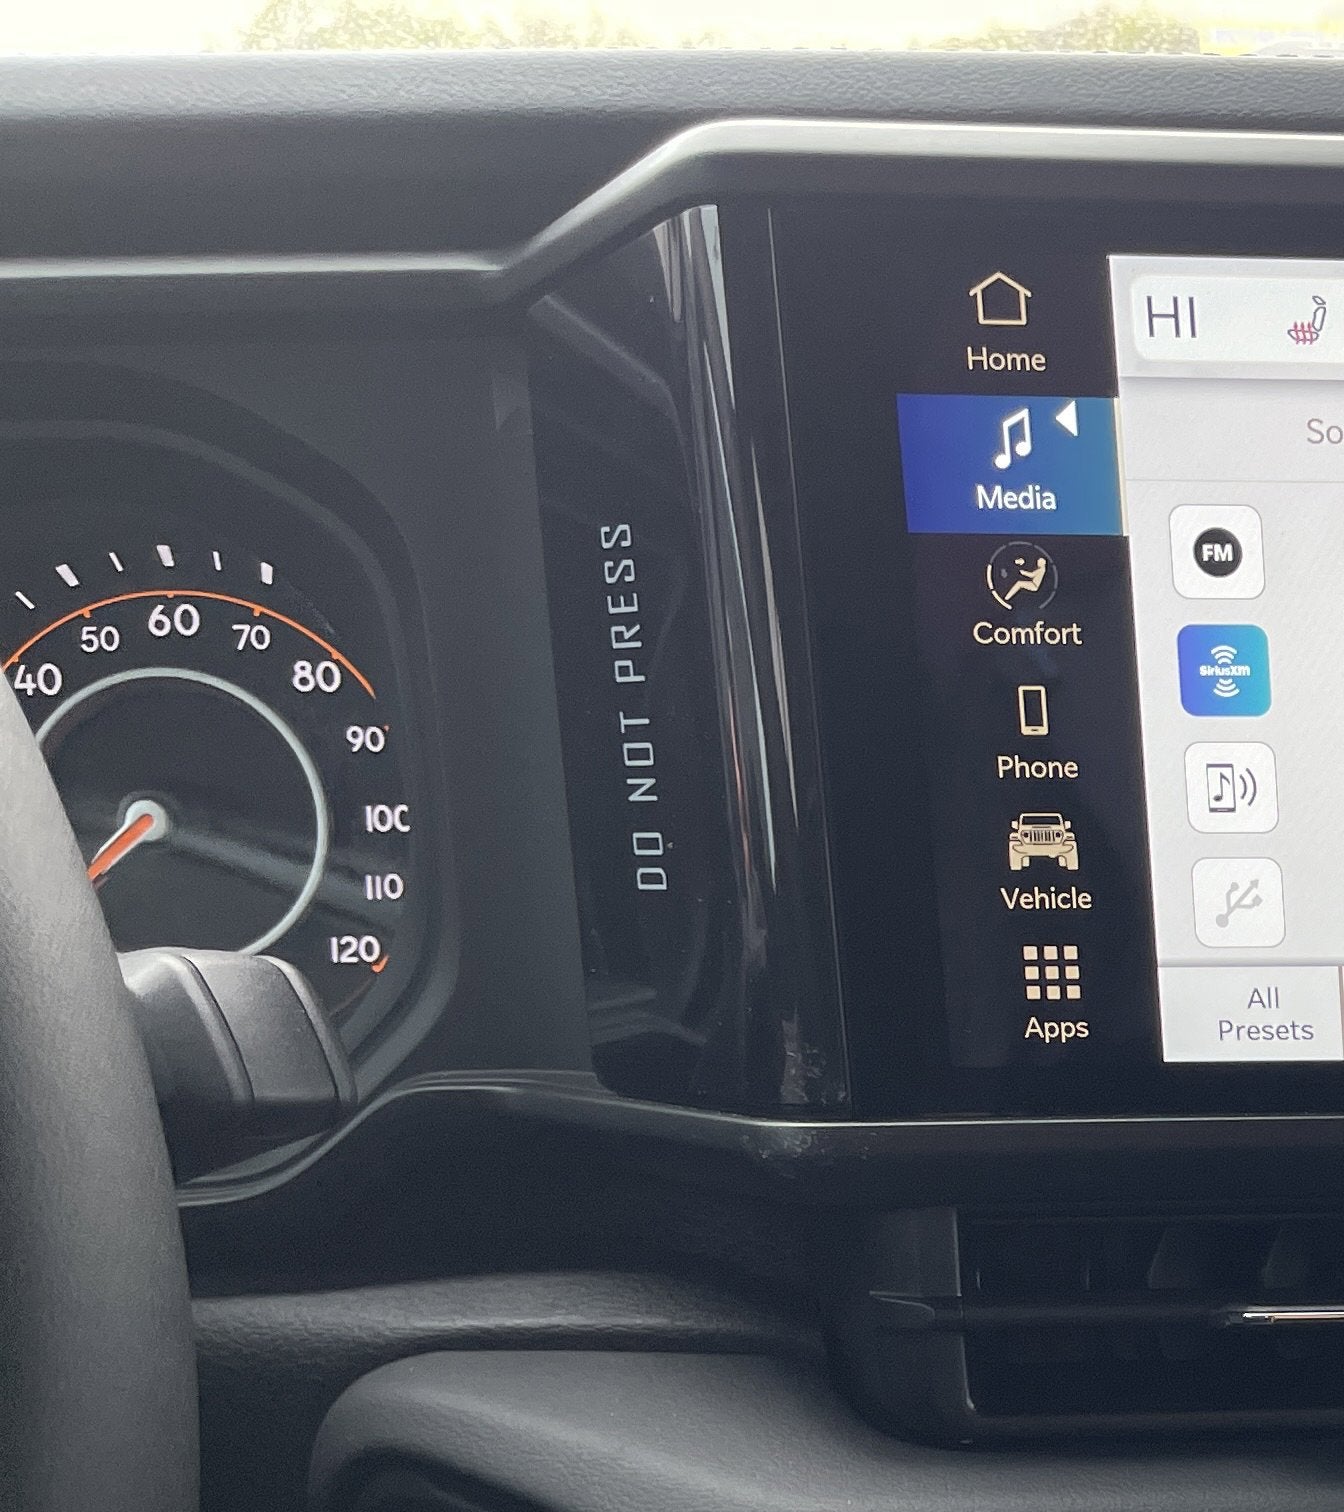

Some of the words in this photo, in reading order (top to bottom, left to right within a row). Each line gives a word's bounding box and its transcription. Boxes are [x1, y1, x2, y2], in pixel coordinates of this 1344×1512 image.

[1145, 295, 1198, 338] HI
[967, 348, 1046, 372] Home
[976, 485, 1058, 512] Media
[1201, 542, 1234, 562] FM
[600, 523, 646, 684] PRESS
[147, 603, 201, 637] 60
[973, 620, 1083, 647] Comfort
[80, 626, 121, 653] 50
[232, 625, 272, 652] 70
[12, 662, 63, 697] 40
[291, 660, 342, 694] 80
[345, 726, 386, 753] 90
[619, 711, 659, 802] NOT
[996, 754, 1079, 780] Phone
[633, 831, 669, 892] DO
[364, 874, 404, 901] 110
[1000, 885, 1093, 912] Vehicle
[329, 935, 382, 964] 120
[1246, 985, 1280, 1011] All
[1023, 1015, 1090, 1044] Apps
[1218, 1017, 1315, 1044] Presets
